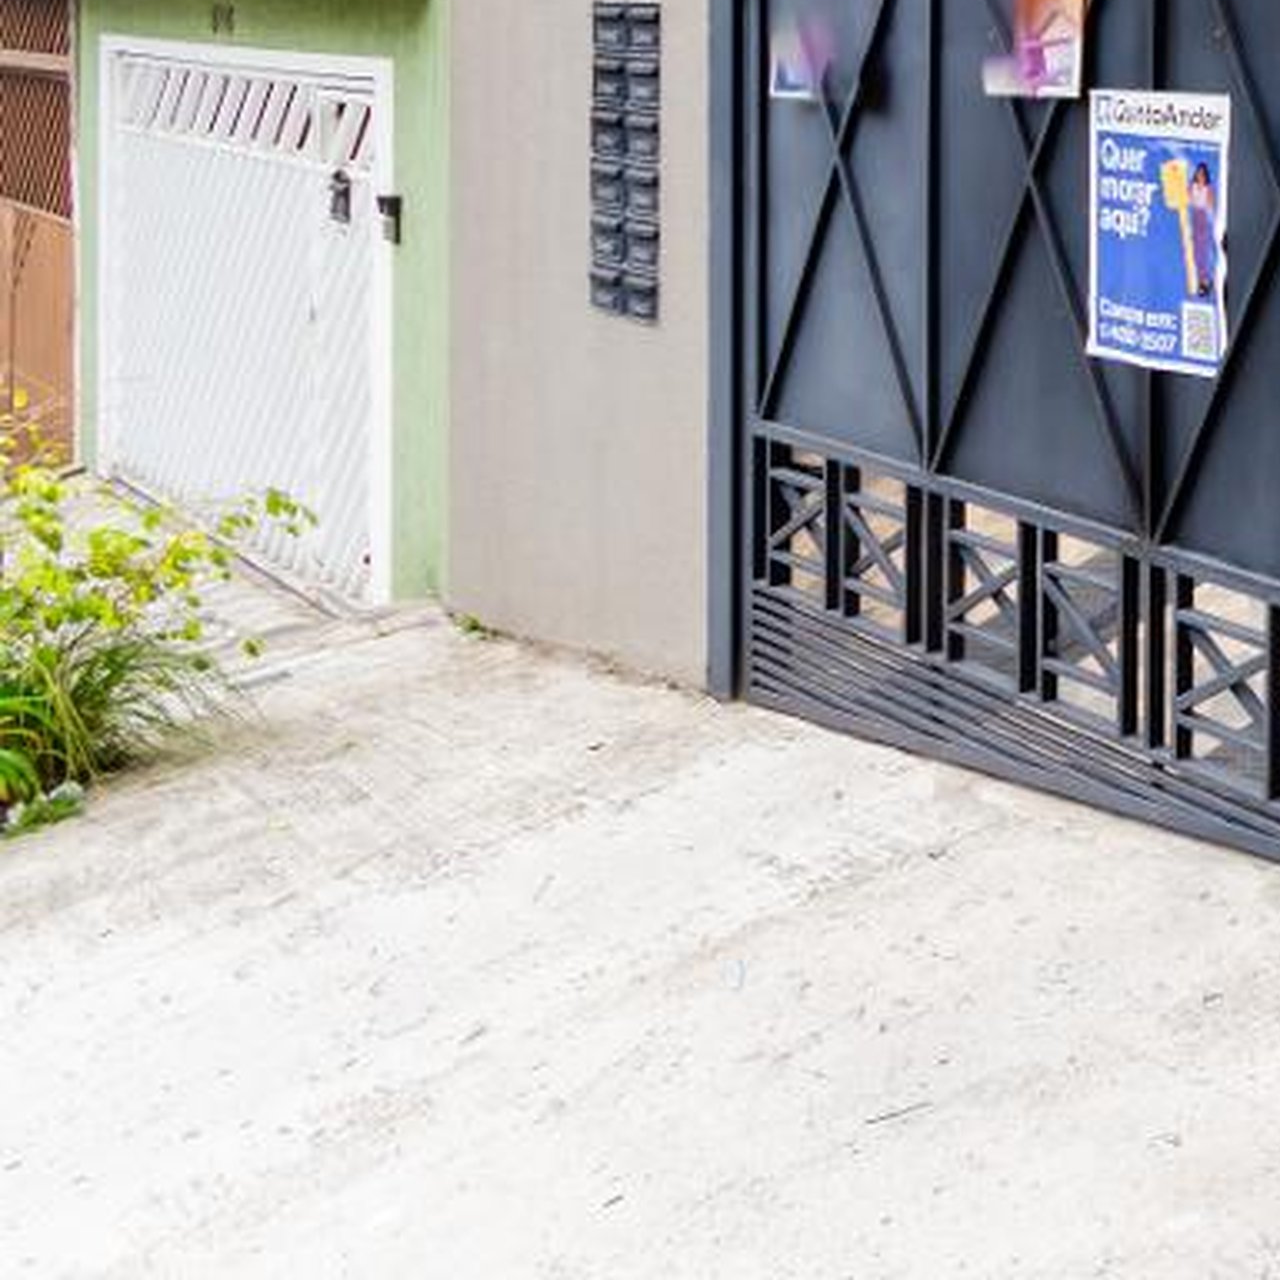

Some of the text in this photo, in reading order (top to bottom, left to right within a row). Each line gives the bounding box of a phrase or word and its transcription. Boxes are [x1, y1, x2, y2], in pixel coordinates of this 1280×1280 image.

[1101, 138, 1148, 172] Quer
[1100, 176, 1158, 206] morar
[1100, 205, 1150, 239] aqui?
